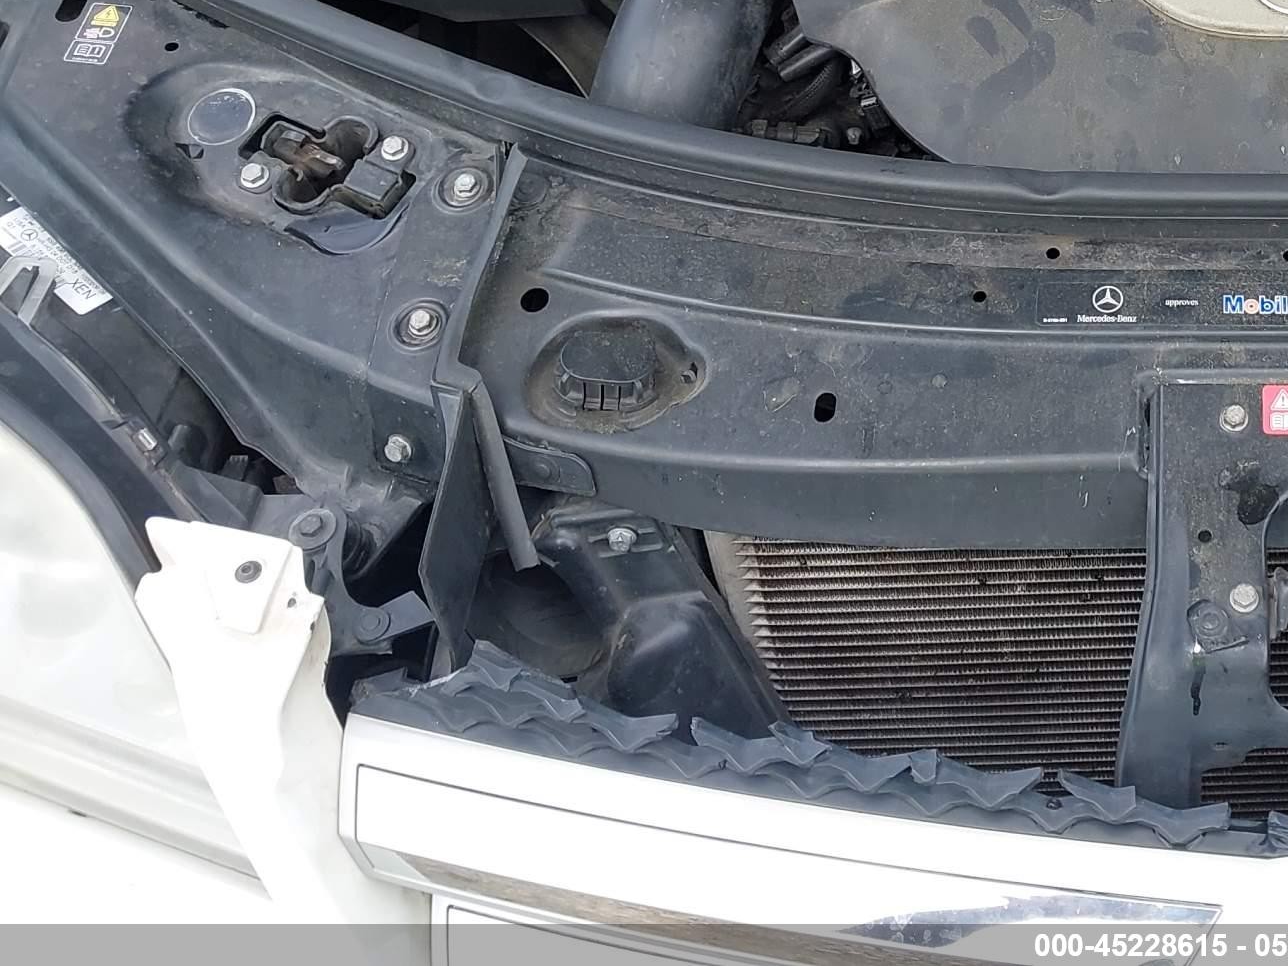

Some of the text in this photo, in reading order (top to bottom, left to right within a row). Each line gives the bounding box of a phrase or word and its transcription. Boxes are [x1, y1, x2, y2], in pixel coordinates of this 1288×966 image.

[71, 278, 98, 300] XEN
[1223, 294, 1288, 315] Mobil
[1077, 315, 1137, 323] Mercedes-Benz
